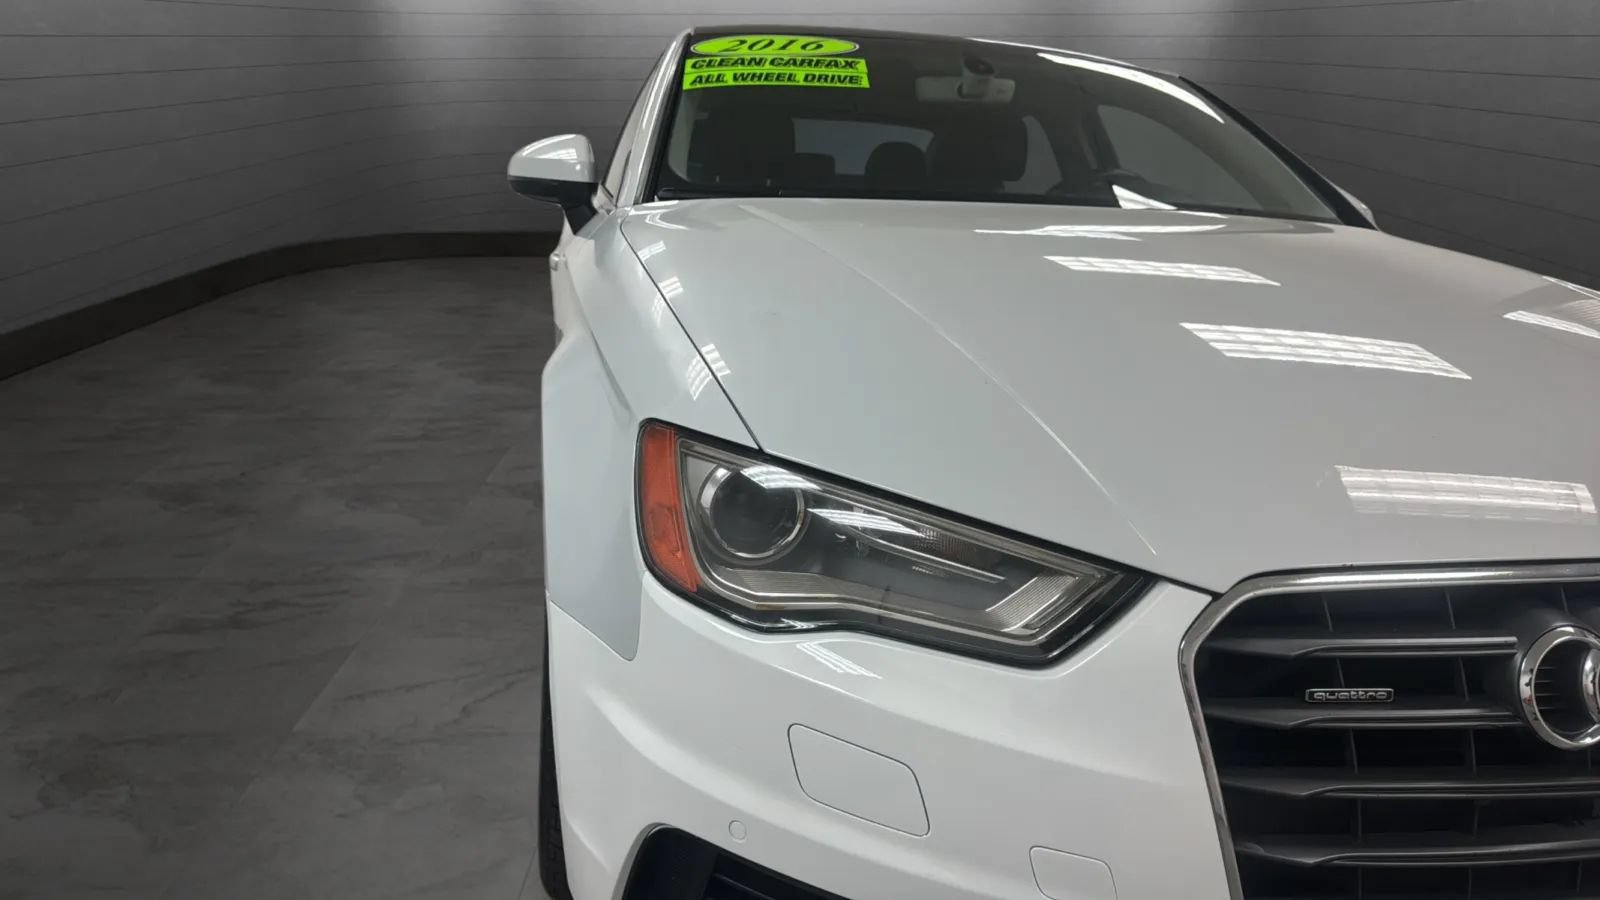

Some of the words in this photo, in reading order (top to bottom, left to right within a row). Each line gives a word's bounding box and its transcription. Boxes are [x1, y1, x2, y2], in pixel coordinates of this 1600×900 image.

[720, 38, 826, 53] 2016
[690, 57, 765, 70] CLEAN
[769, 57, 860, 70] CARFAX
[689, 73, 728, 86] ALL
[732, 72, 800, 83] WHEEL
[802, 73, 863, 85] DRIVE
[1313, 690, 1388, 701] quattro
